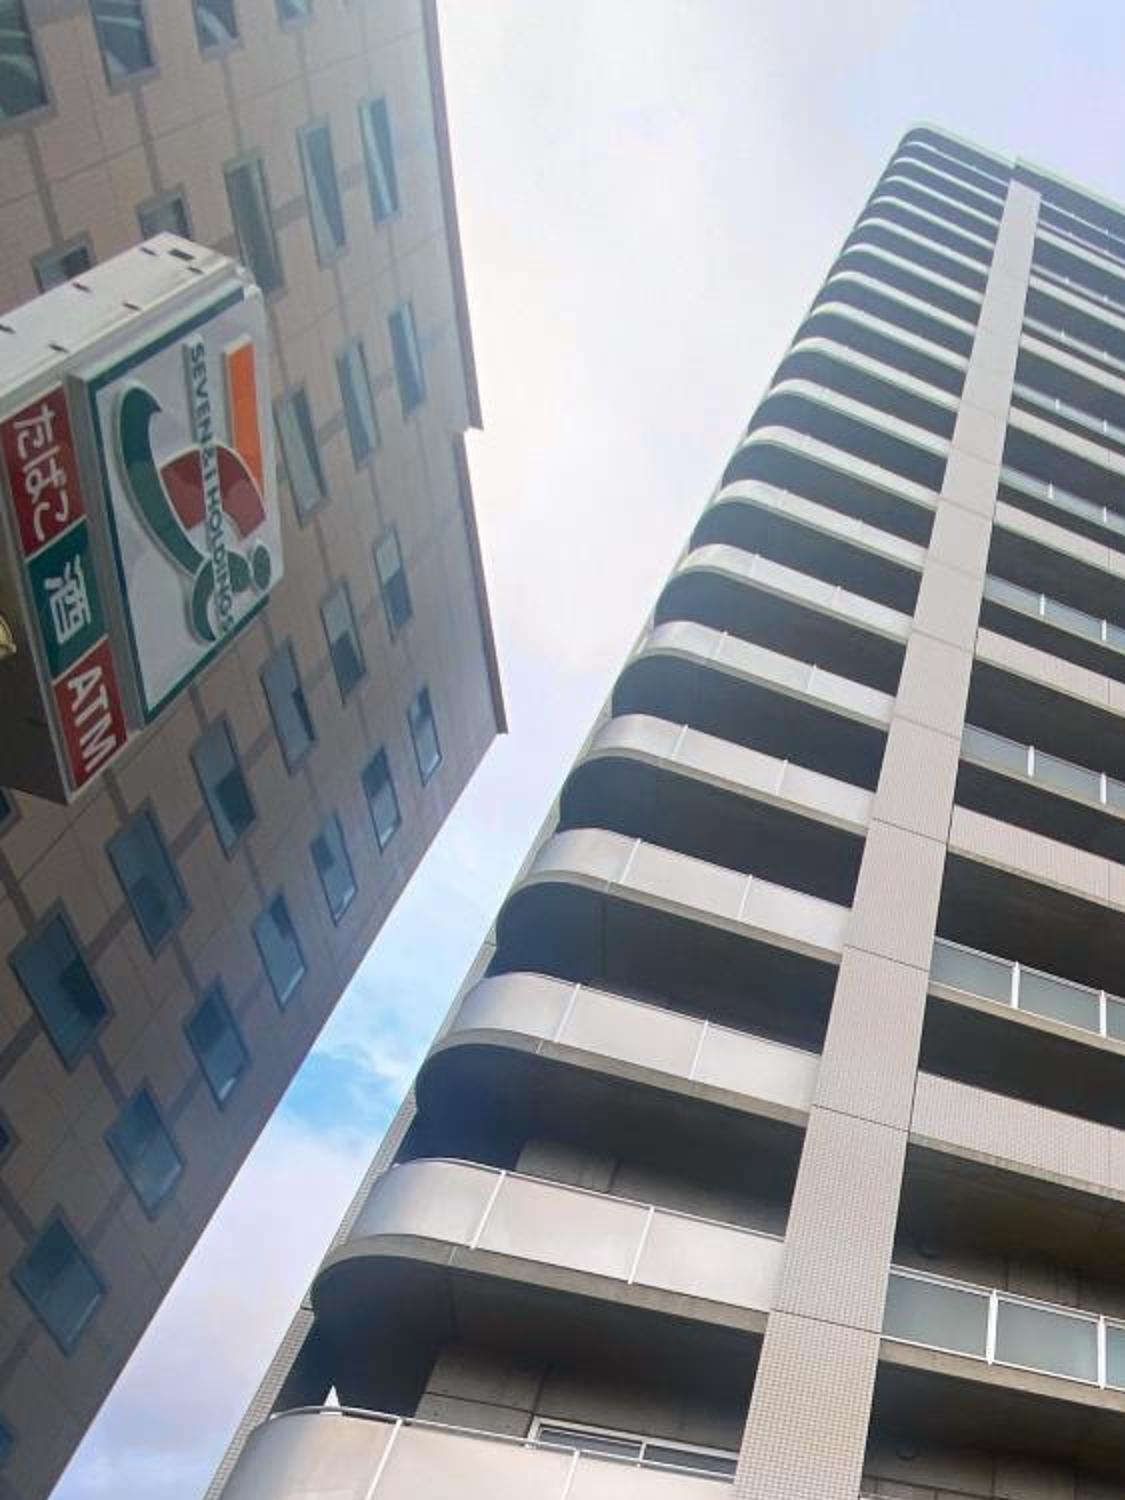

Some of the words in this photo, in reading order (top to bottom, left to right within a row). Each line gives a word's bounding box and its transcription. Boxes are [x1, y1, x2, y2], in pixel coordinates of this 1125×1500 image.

[14, 403, 69, 541] たばこ
[44, 554, 92, 646] 酒
[67, 664, 117, 774] ATM
